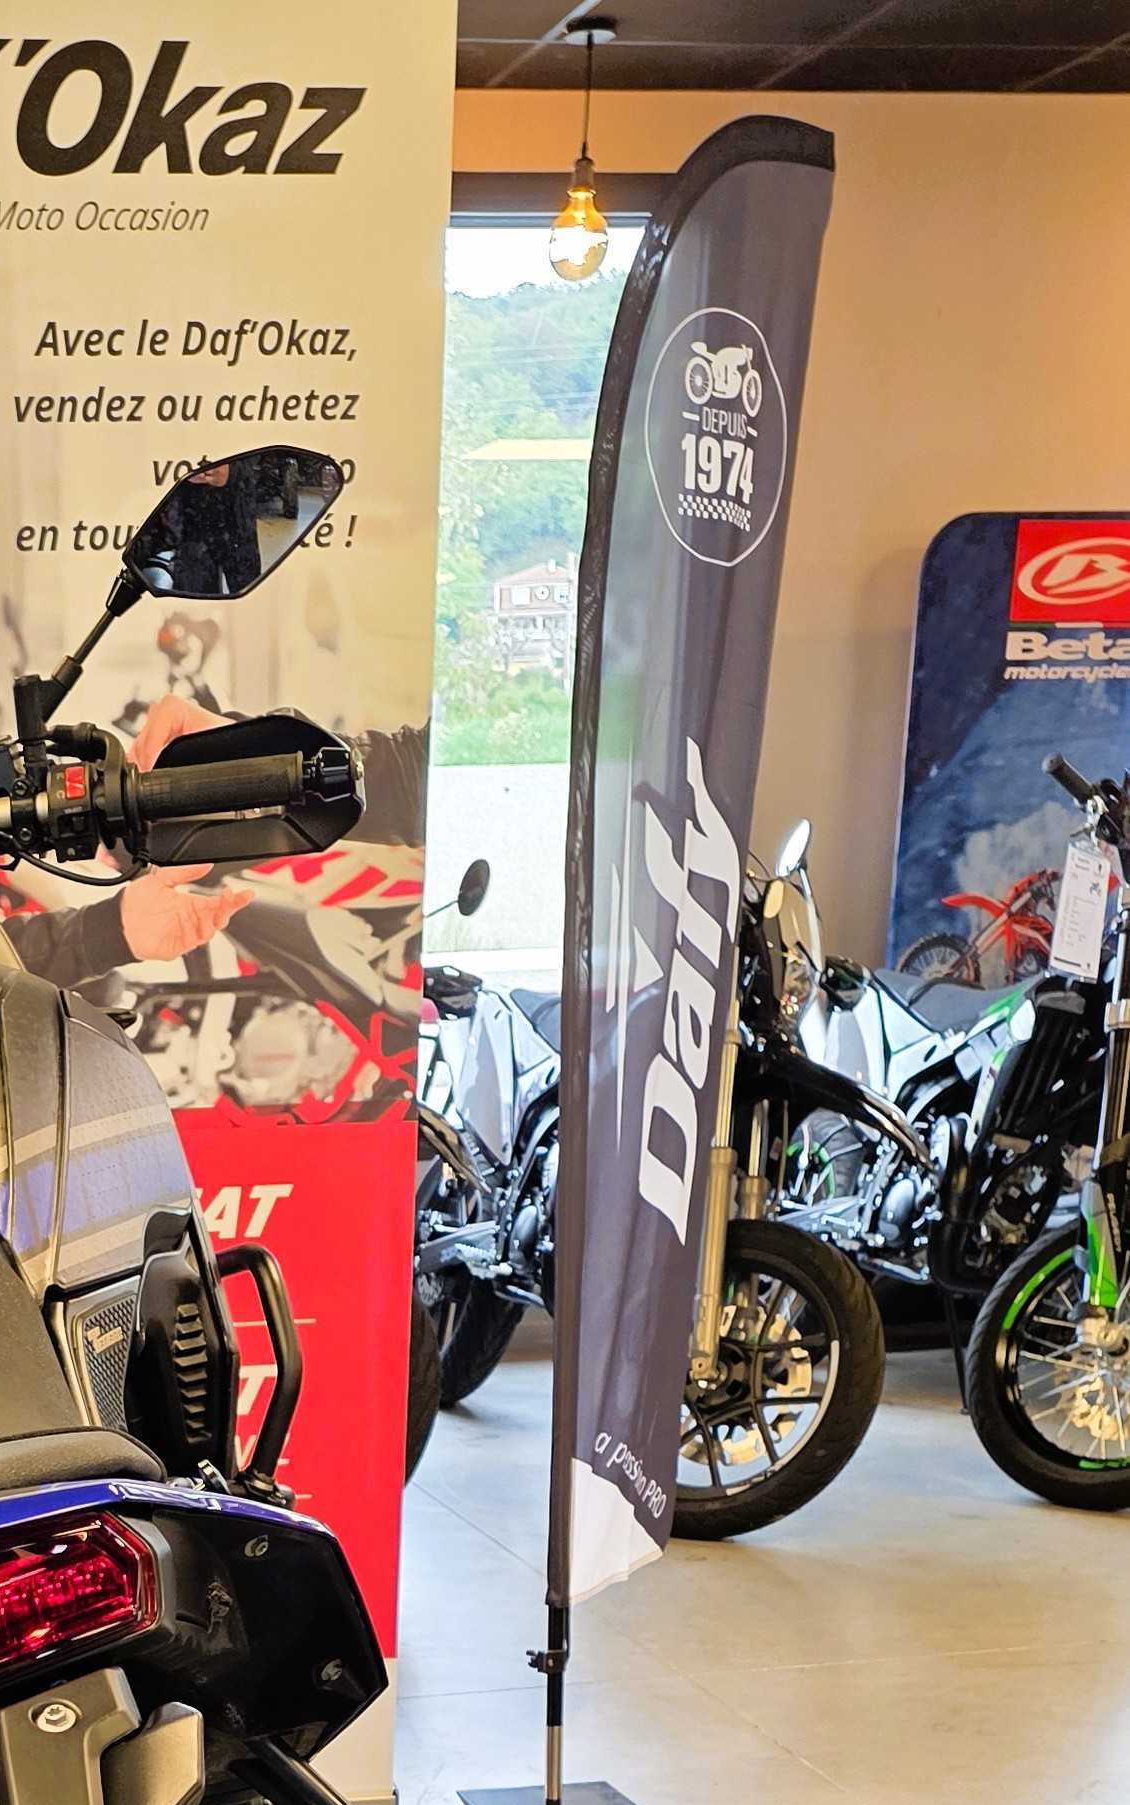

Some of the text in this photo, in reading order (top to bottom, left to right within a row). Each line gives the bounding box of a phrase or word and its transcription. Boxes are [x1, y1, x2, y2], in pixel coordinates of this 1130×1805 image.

[75, 201, 210, 231] Occasion
[34, 319, 357, 366] Avec le Daf'Okaz,
[13, 385, 360, 423] vendez ou achetez
[701, 406, 748, 439] DEPUIS
[681, 433, 754, 505] 1974
[16, 524, 60, 551] en
[1004, 662, 1130, 684] motorcycle
[595, 1432, 612, 1454] a
